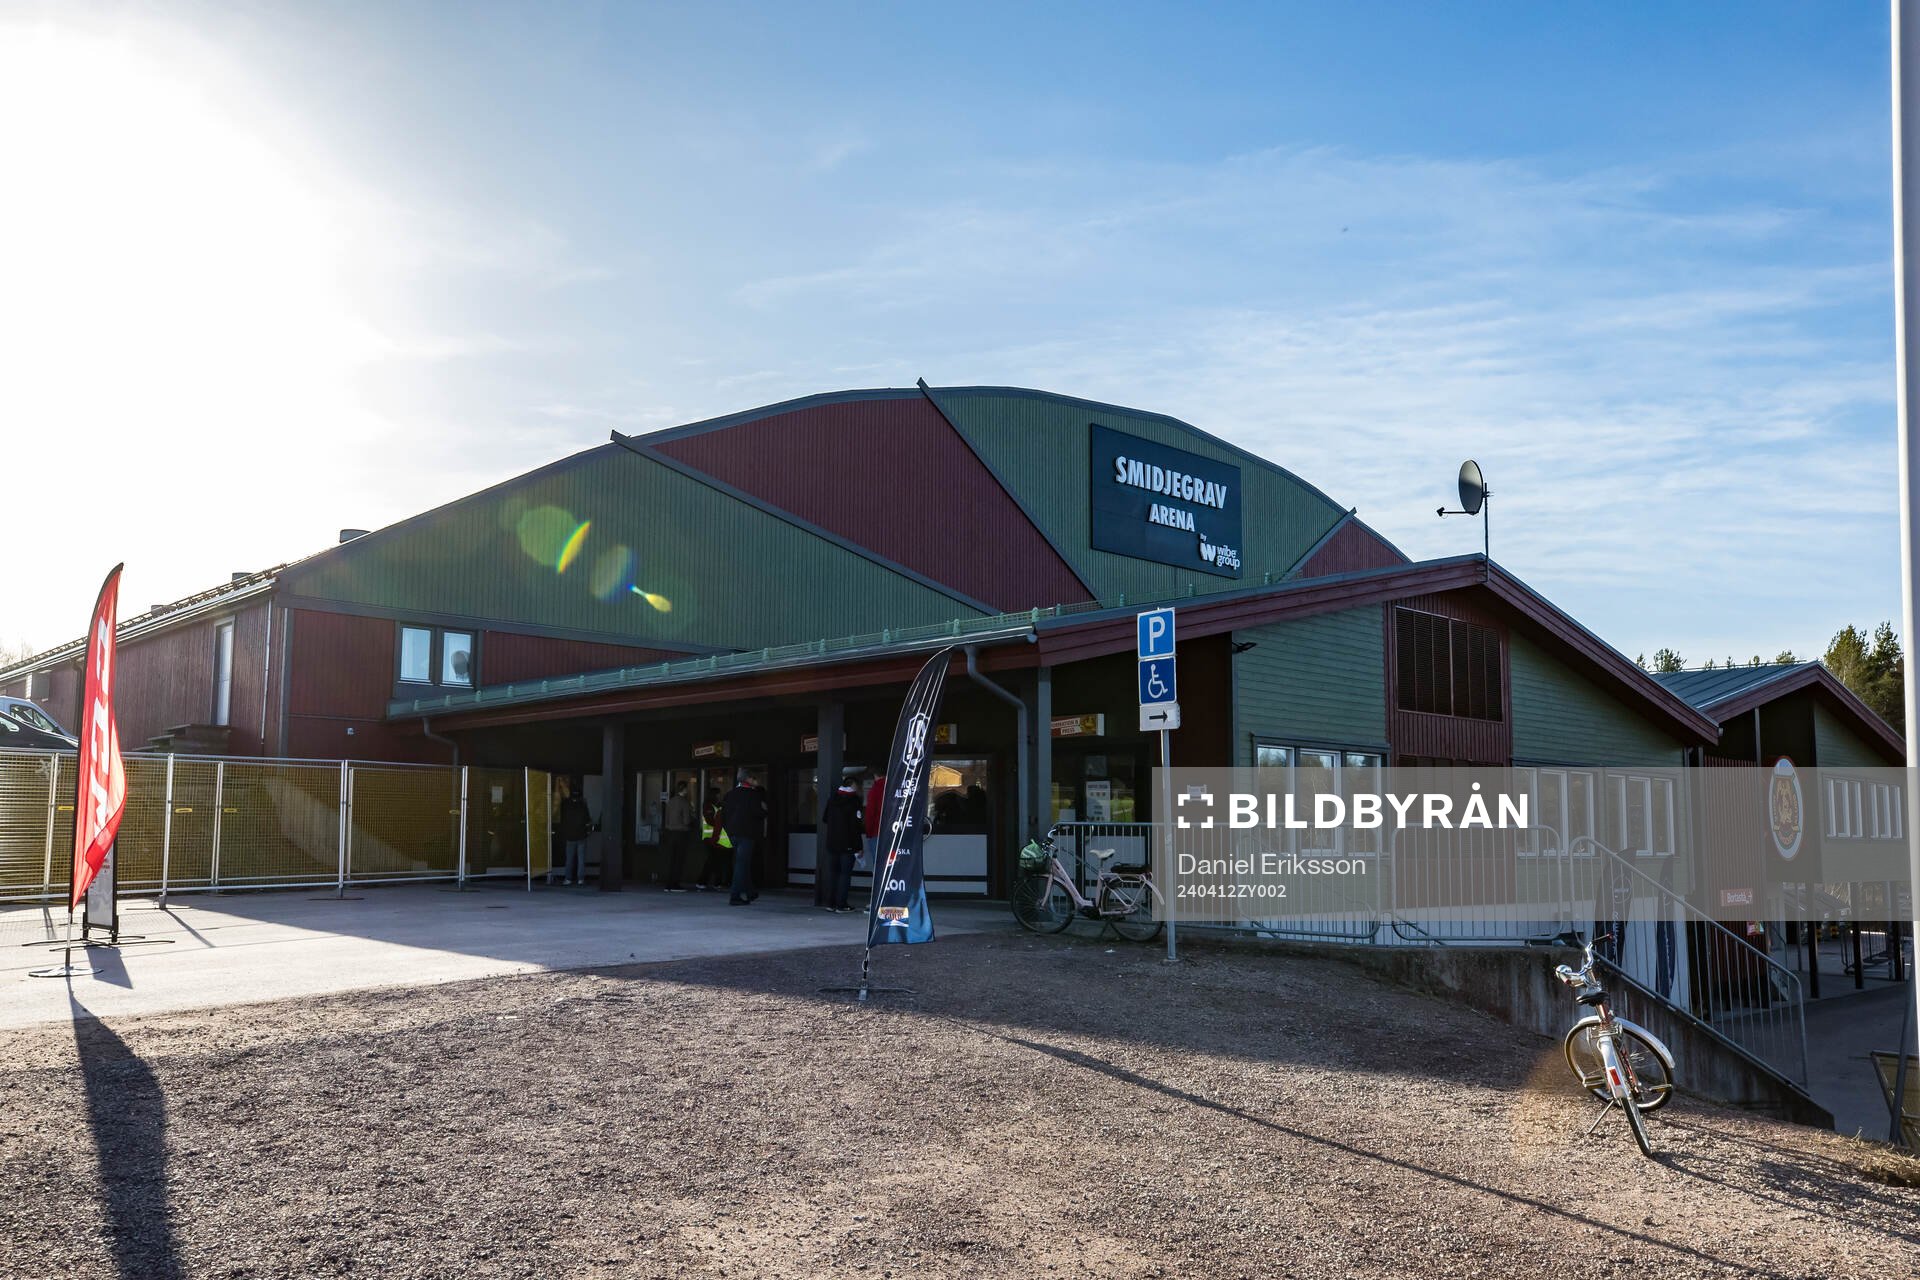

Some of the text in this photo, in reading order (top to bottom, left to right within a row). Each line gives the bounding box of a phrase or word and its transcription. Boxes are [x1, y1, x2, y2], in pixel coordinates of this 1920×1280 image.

[1115, 456, 1227, 509] SMIDJEGRAV
[1149, 503, 1195, 532] ARENA
[1217, 555, 1240, 570] group
[1149, 616, 1165, 652] P
